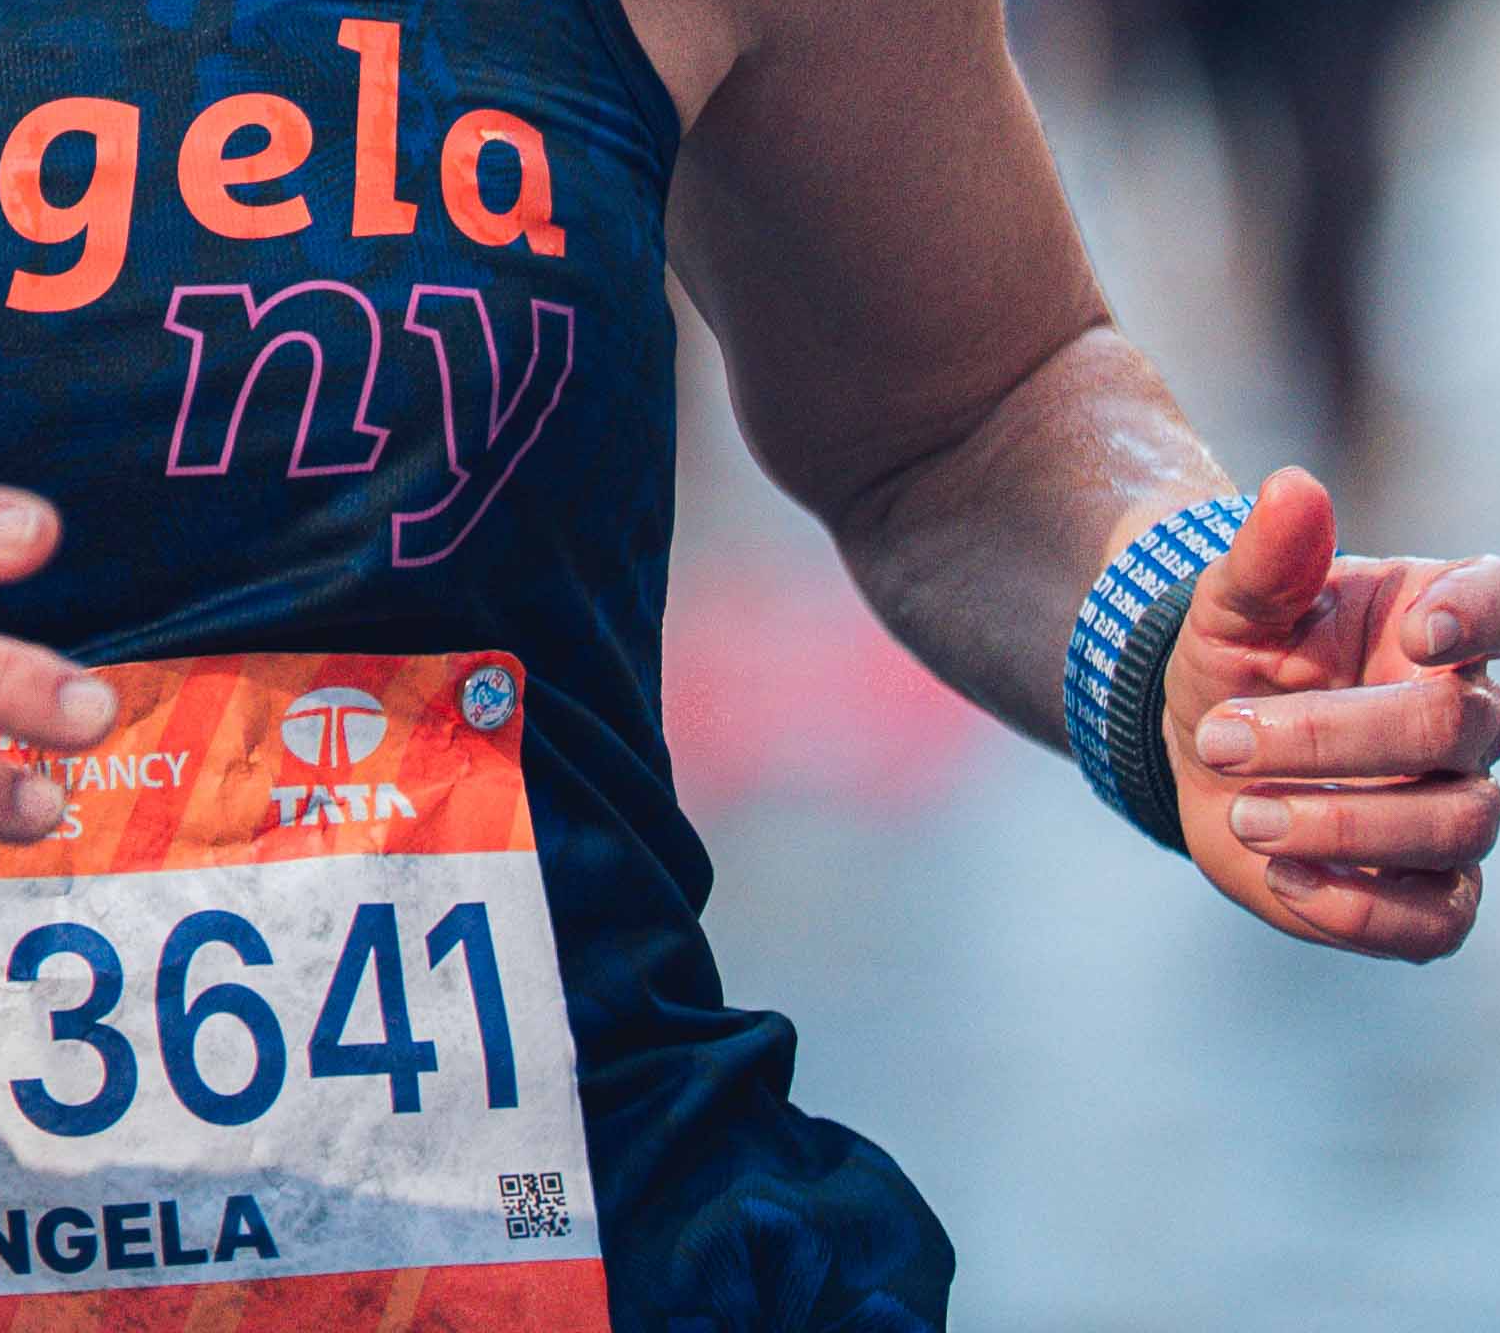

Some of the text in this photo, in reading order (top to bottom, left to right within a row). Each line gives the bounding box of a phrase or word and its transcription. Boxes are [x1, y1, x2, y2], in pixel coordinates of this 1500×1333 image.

[163, 280, 576, 568] ny
[270, 782, 418, 827] TATA
[8, 902, 521, 1138] 3641
